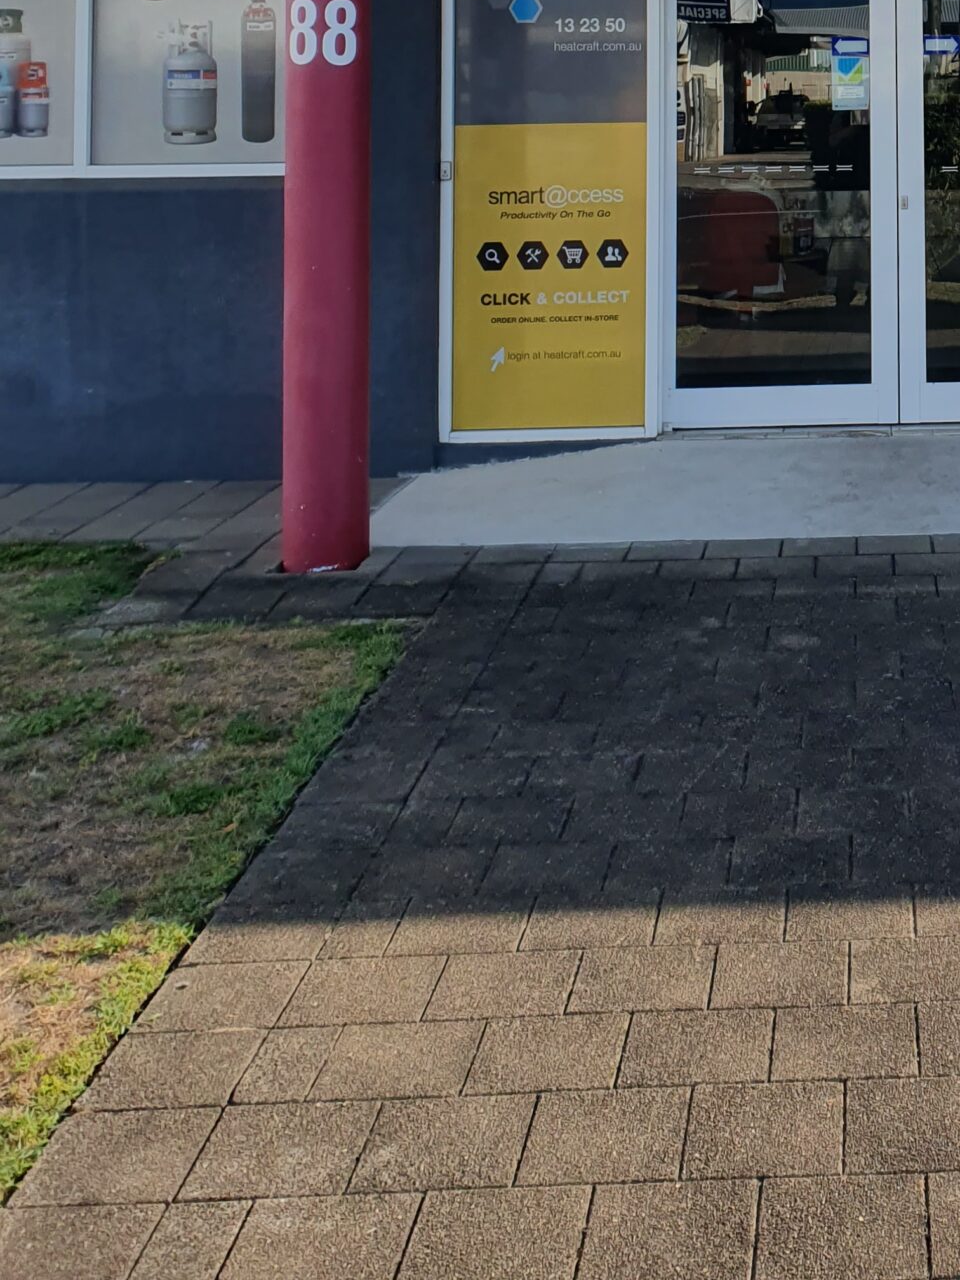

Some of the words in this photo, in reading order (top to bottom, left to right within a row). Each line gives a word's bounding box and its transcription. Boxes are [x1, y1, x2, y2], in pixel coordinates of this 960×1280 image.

[555, 17, 575, 33] 13
[579, 17, 600, 33] 23
[605, 17, 626, 33] 50
[553, 40, 642, 52] heatcraft.com.au
[488, 184, 624, 208] smart@ccess
[500, 211, 557, 220] Productivity
[560, 210, 574, 218] On
[577, 210, 594, 218] The
[597, 209, 611, 218] Go
[480, 293, 531, 306] CLICK
[536, 292, 548, 305] &
[553, 290, 630, 304] COLLECT
[584, 314, 619, 322] IN-STORE
[507, 351, 530, 362] login
[532, 351, 541, 360] at
[543, 350, 622, 360] heatcraft.com.au
